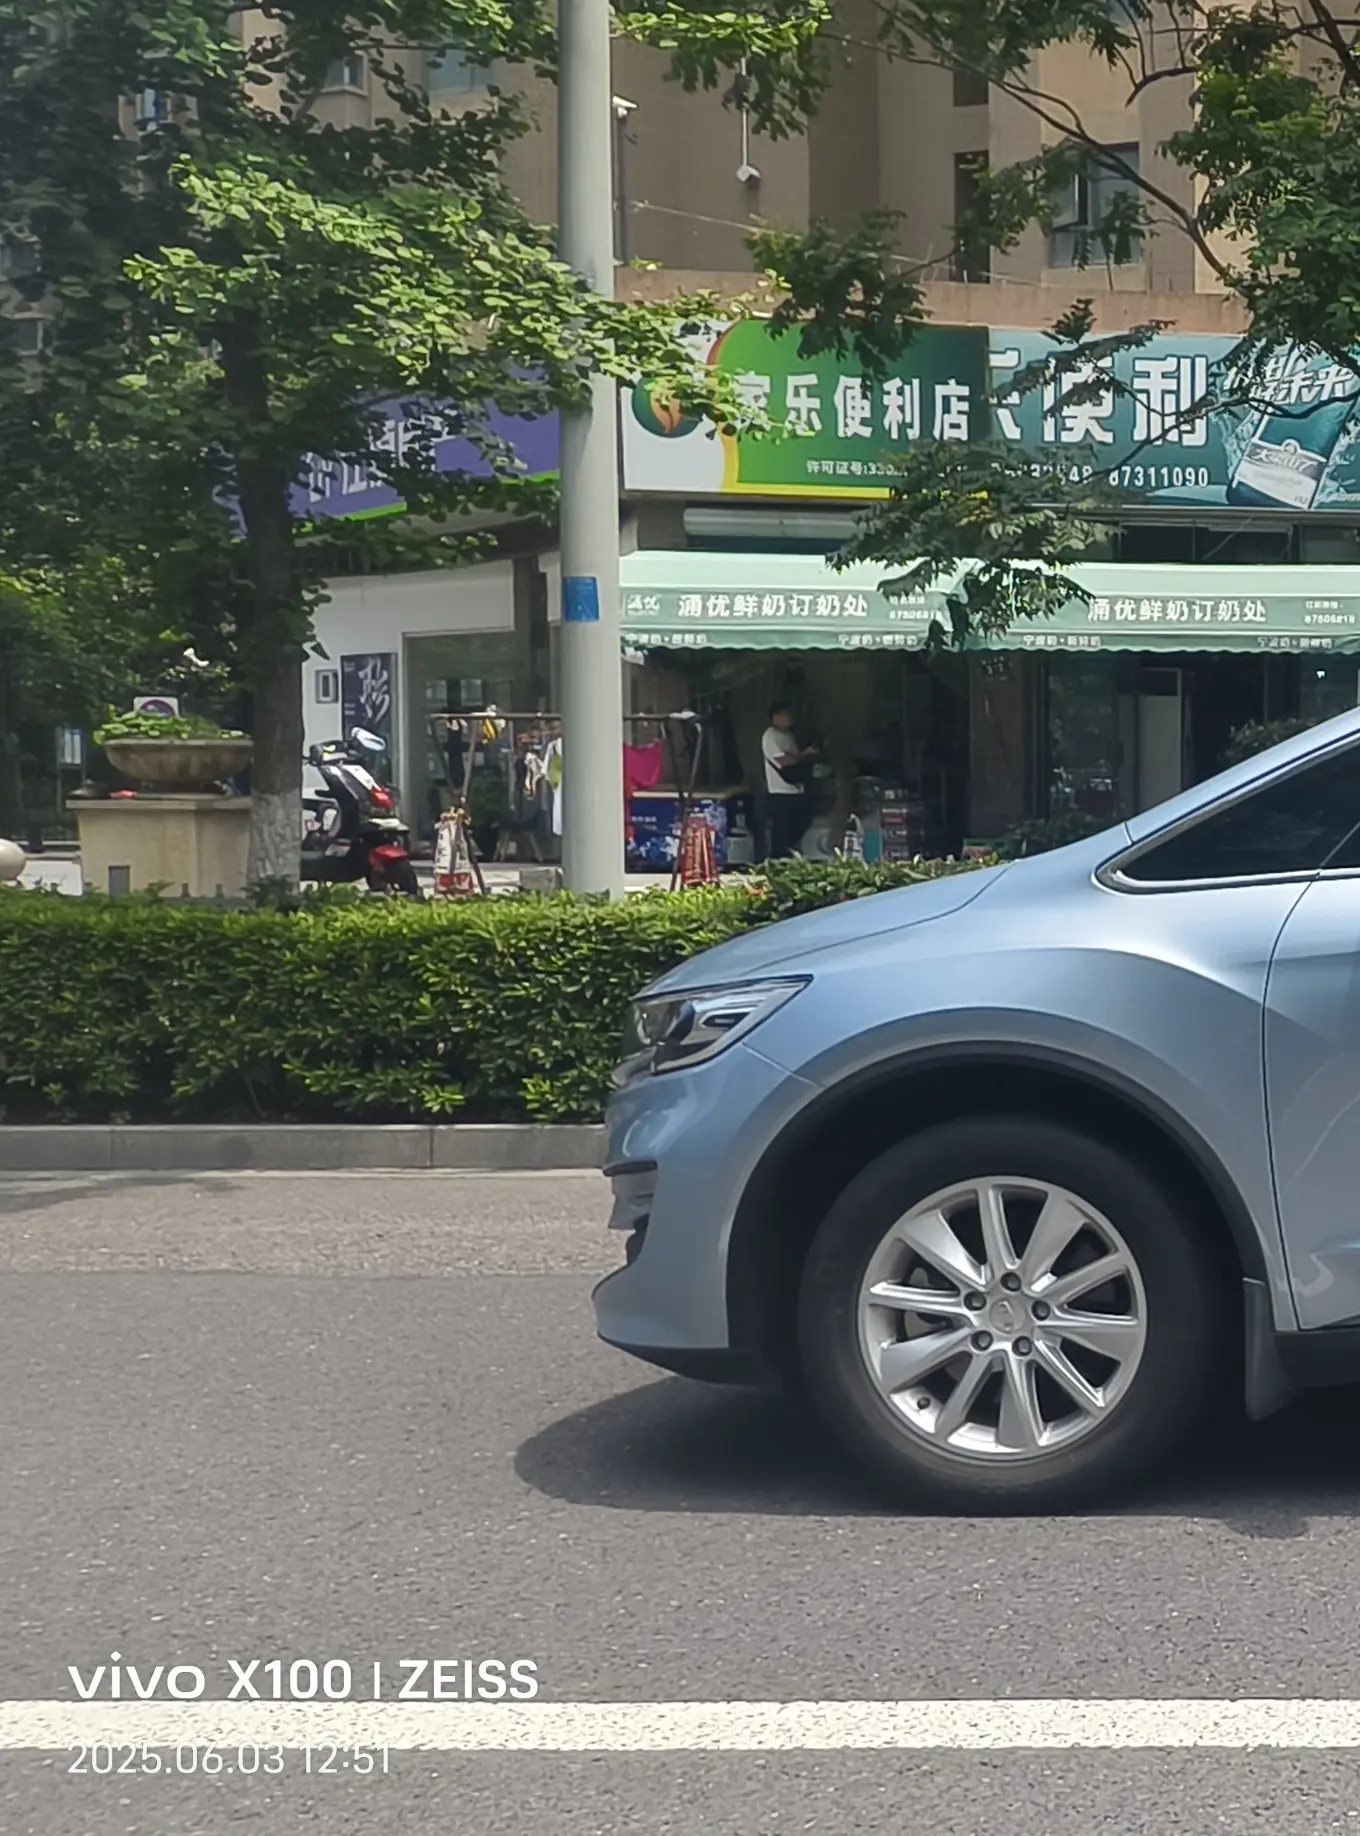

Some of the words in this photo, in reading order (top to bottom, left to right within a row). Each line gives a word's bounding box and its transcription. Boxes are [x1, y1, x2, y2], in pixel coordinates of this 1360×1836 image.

[733, 370, 972, 442] 家乐便利店
[1108, 465, 1209, 487] 87311090
